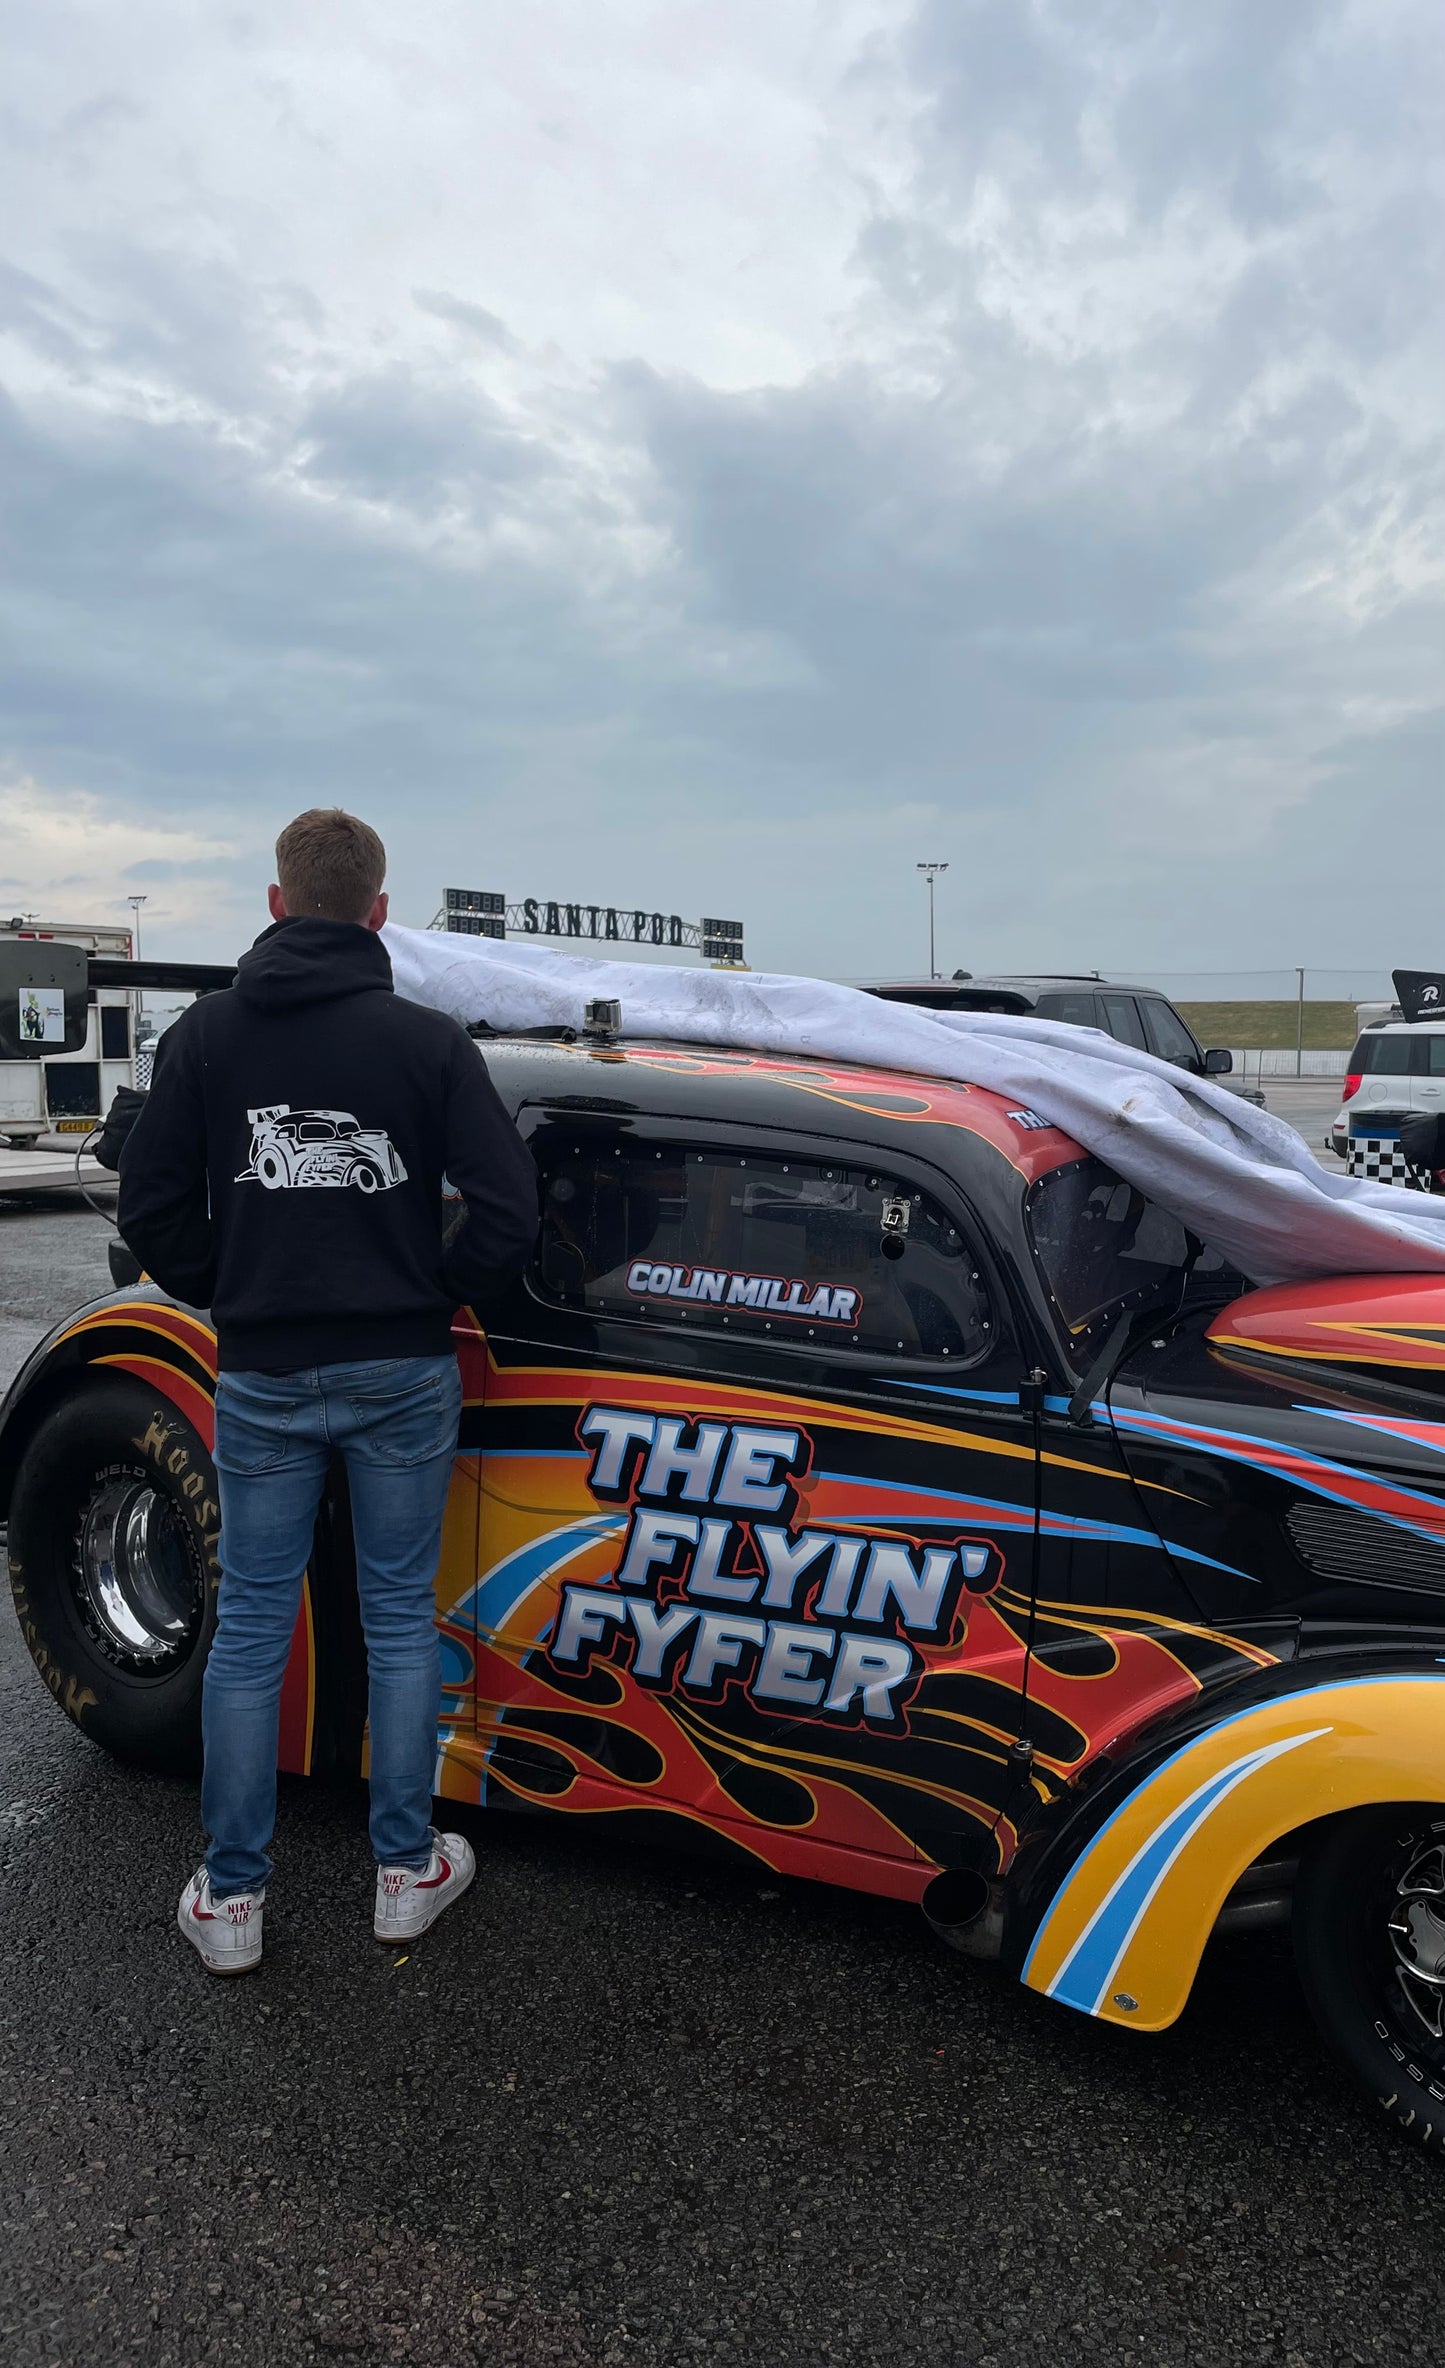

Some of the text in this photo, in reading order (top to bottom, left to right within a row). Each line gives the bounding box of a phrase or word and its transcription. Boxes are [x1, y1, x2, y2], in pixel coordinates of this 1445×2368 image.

[523, 898, 683, 946] SANTA POD
[627, 1262, 857, 1320] COLIN MILLAR
[96, 1464, 147, 1482] WELD
[583, 1407, 800, 1511] THE
[619, 1507, 989, 1632] FLYIN'
[551, 1585, 912, 1721] FYFER
[383, 1873, 406, 1885] NIKE
[384, 1884, 400, 1895] AIR
[227, 1900, 252, 1915] NIKE
[231, 1912, 249, 1925] AIR
